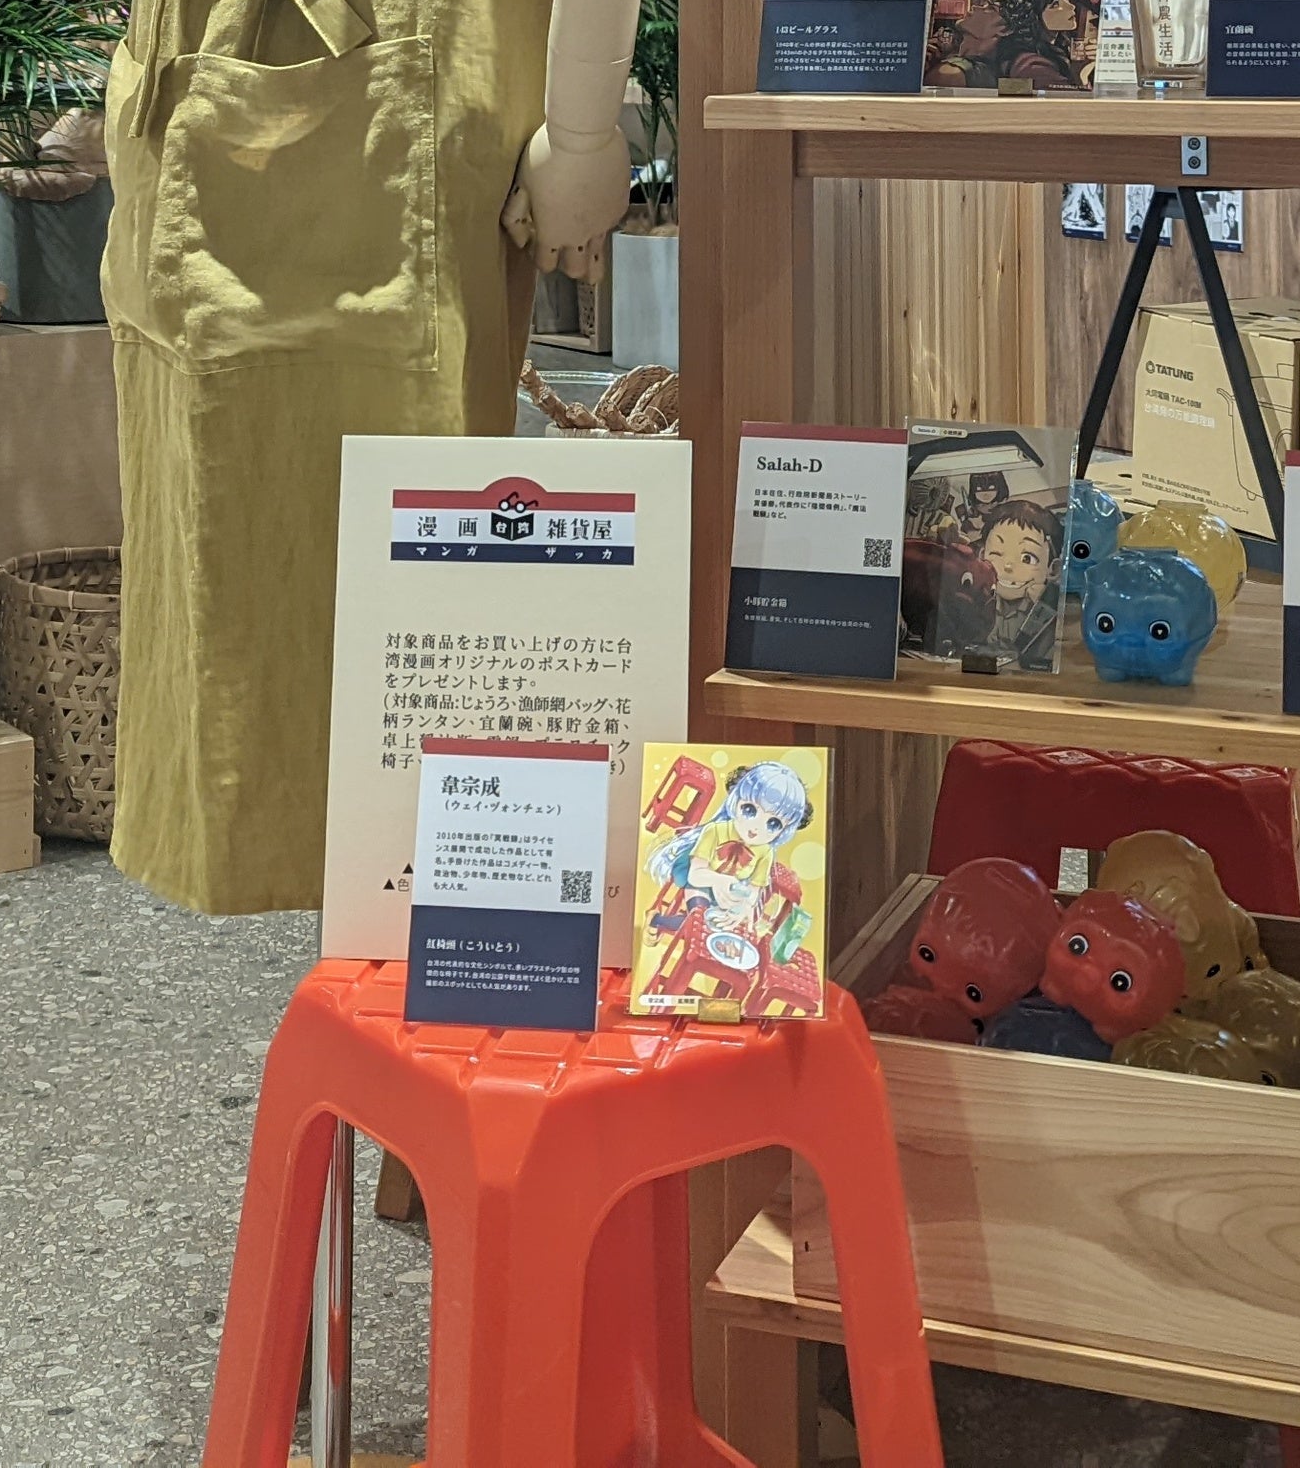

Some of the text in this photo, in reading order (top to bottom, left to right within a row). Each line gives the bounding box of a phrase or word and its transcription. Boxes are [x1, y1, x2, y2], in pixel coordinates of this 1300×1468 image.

[1155, 363, 1195, 382] TATUNG
[756, 455, 823, 474] Salah-D
[416, 515, 614, 541] 漫画 台湾 雑貨屋
[415, 545, 614, 561] マンガ ザッカ
[384, 632, 633, 655] 対象商品をお買い上げの方に台
[384, 652, 633, 674] 湾漫画オリジナルのポストカード
[384, 673, 537, 691] をプレゼントします。
[382, 712, 629, 736] 柄ランタン、宜蘭碗、豚貯金箱、
[440, 774, 502, 798] 韋宗成
[435, 844, 553, 858] ンス展開で成功した作品として有
[433, 869, 552, 883] 政治物、少年物、歴史物など、どれ
[433, 881, 468, 892] も大人気。
